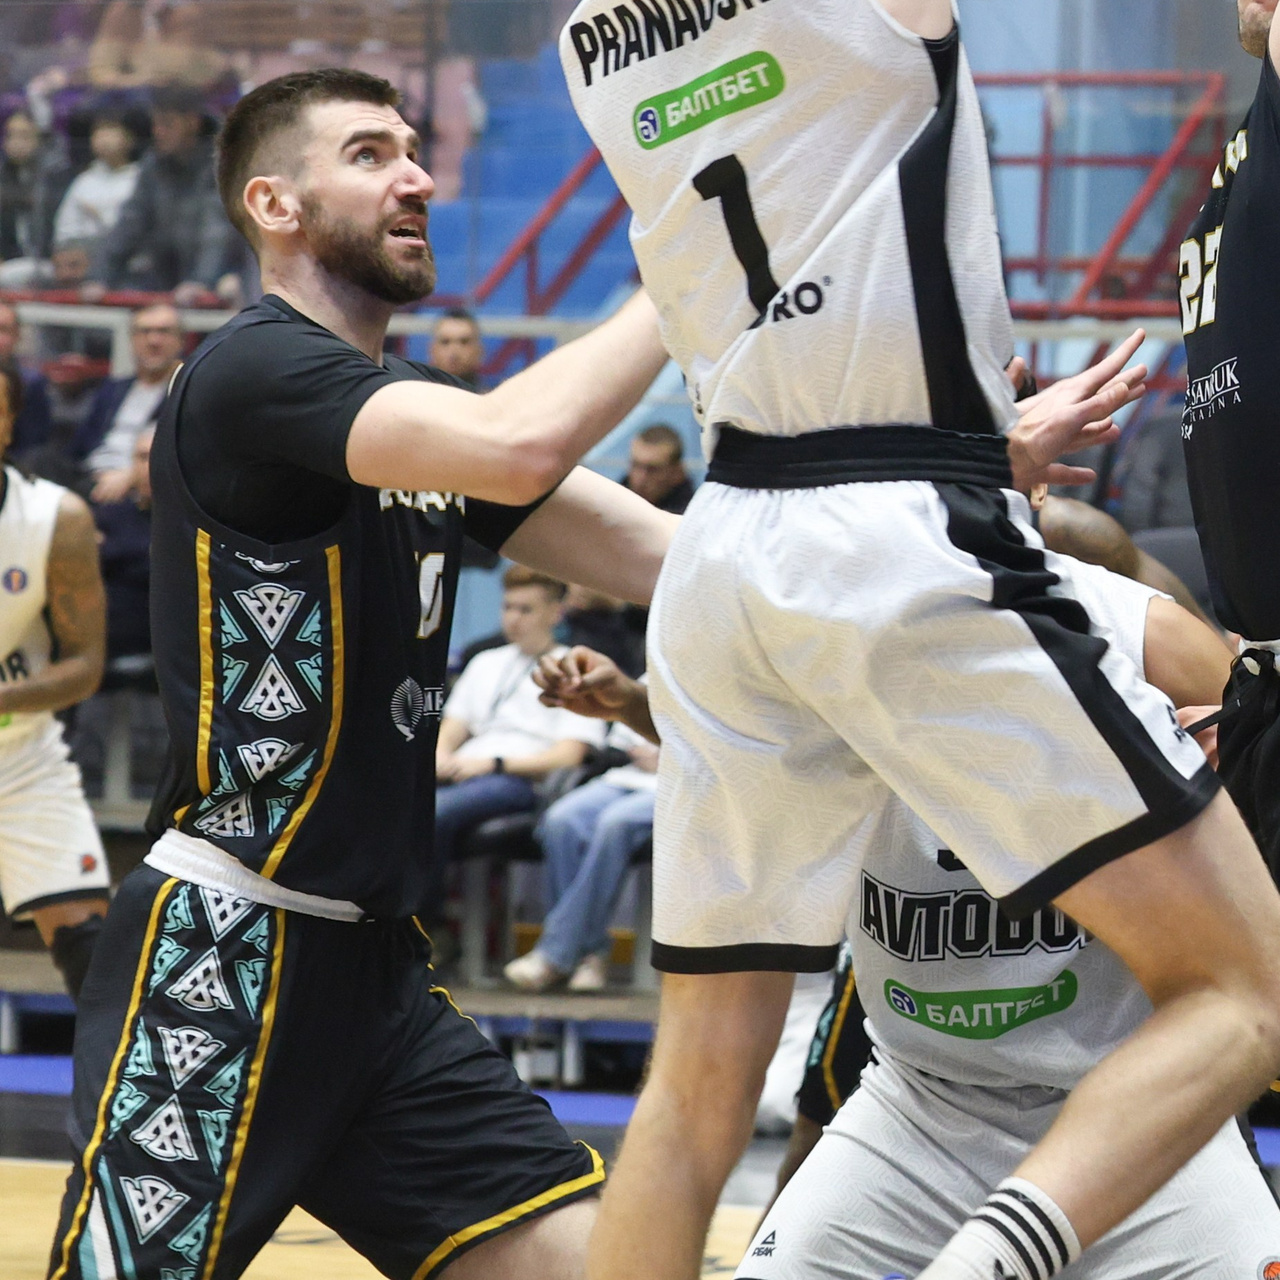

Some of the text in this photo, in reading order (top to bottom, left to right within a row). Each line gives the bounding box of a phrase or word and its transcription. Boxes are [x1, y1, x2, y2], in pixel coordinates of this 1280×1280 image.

[665, 62, 770, 128] БАЛТБЕТ
[692, 153, 781, 330] 1
[860, 868, 1088, 962] AVTODO
